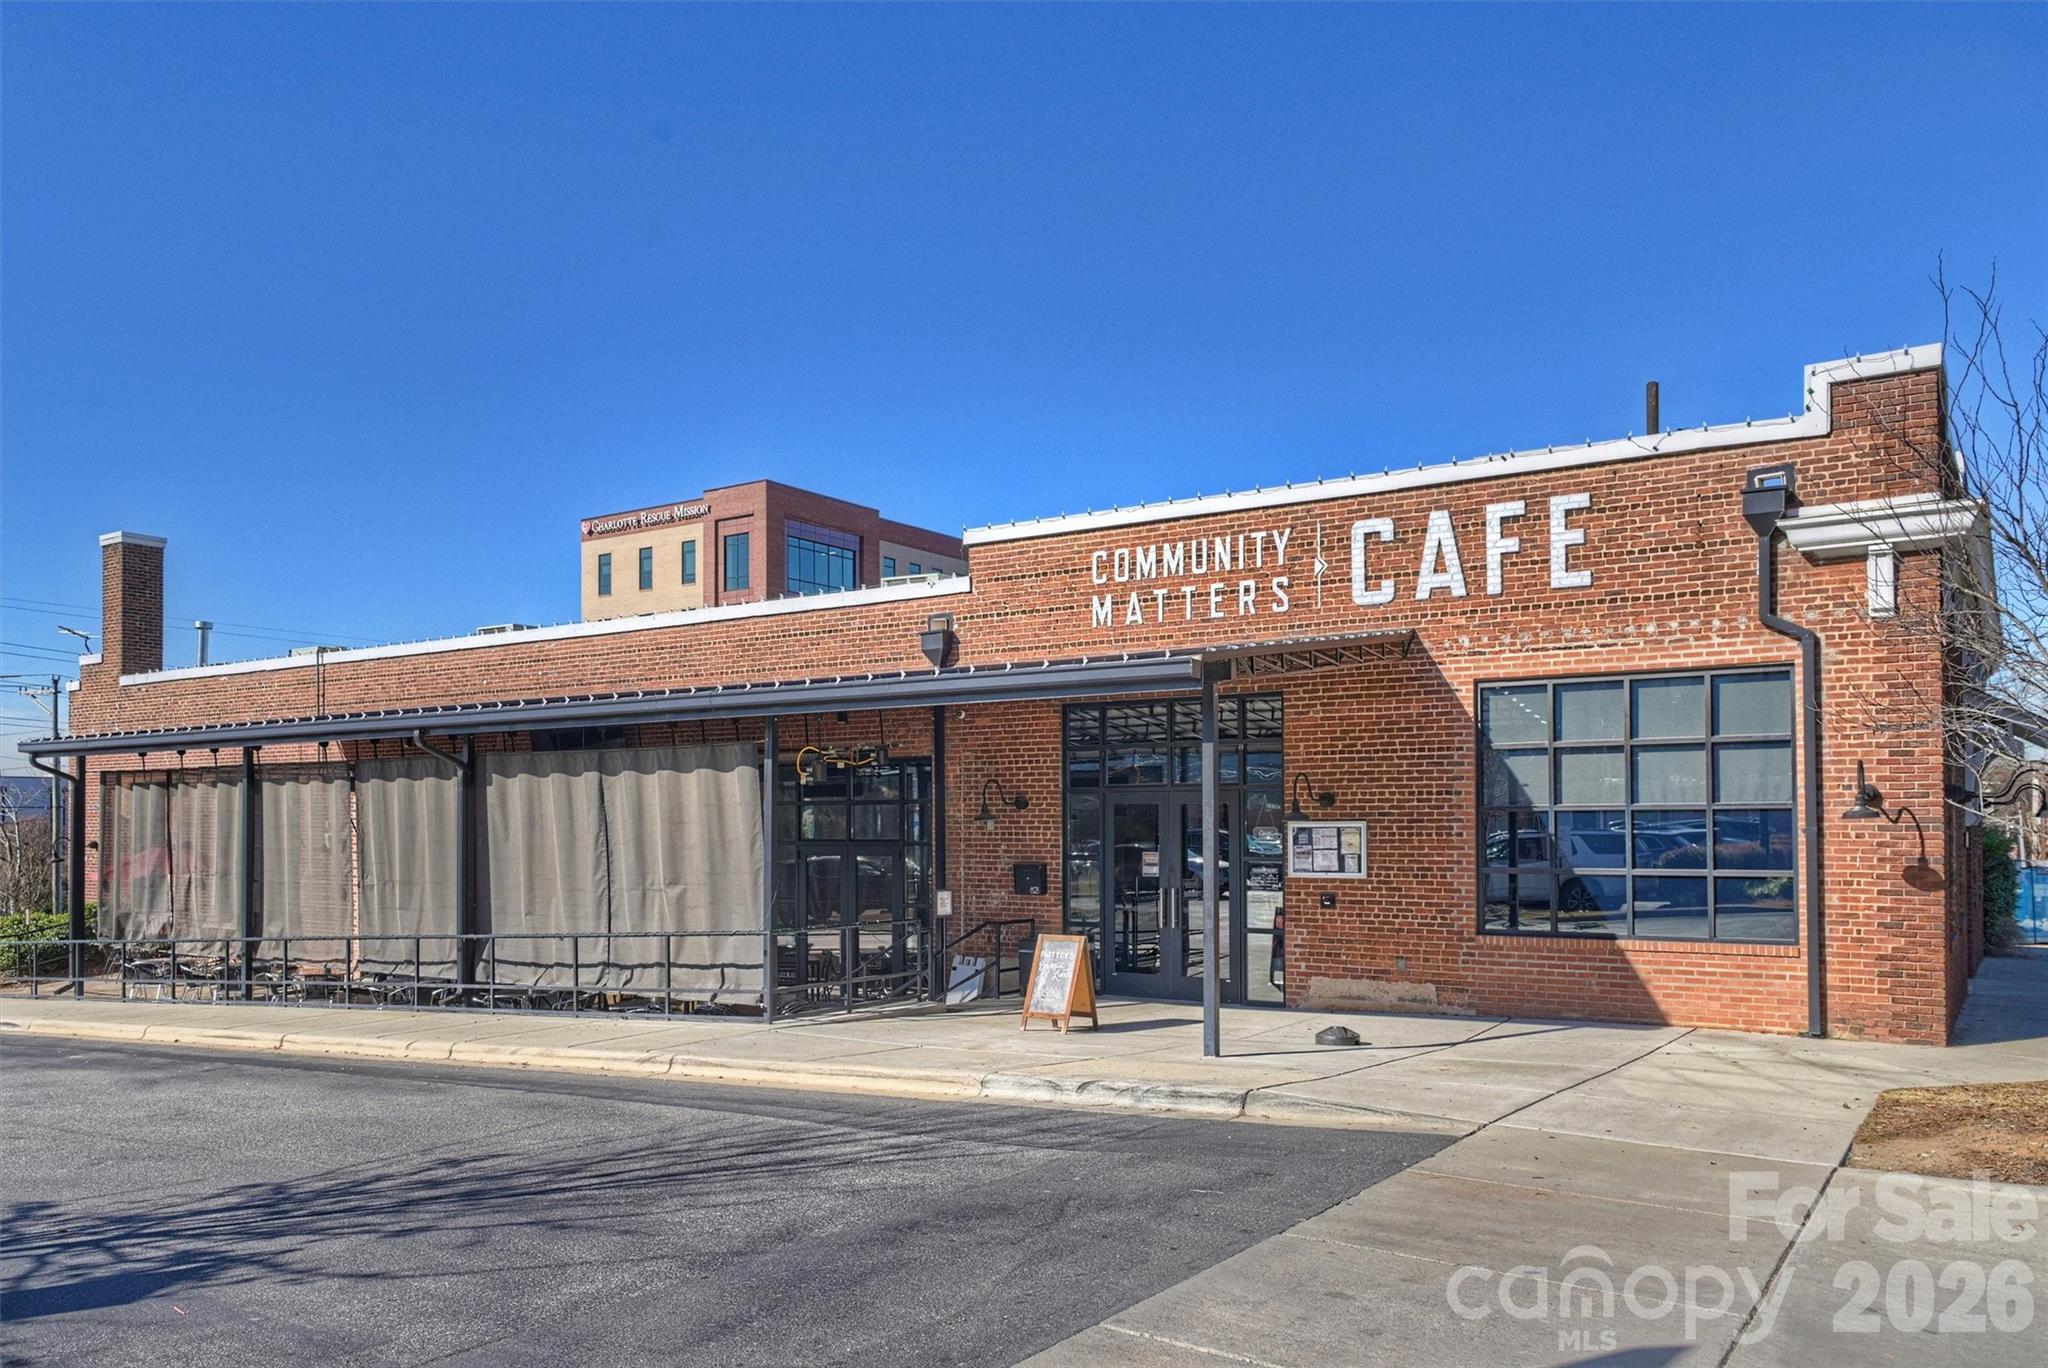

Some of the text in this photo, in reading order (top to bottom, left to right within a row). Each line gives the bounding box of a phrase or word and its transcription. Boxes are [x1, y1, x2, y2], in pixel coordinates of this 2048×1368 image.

[591, 503, 709, 532] CHARLOTTE RESCUE MISSION
[1091, 527, 1292, 585] COMMUNITY
[1350, 491, 1593, 607] CAFE
[1091, 576, 1290, 628] MATTERS
